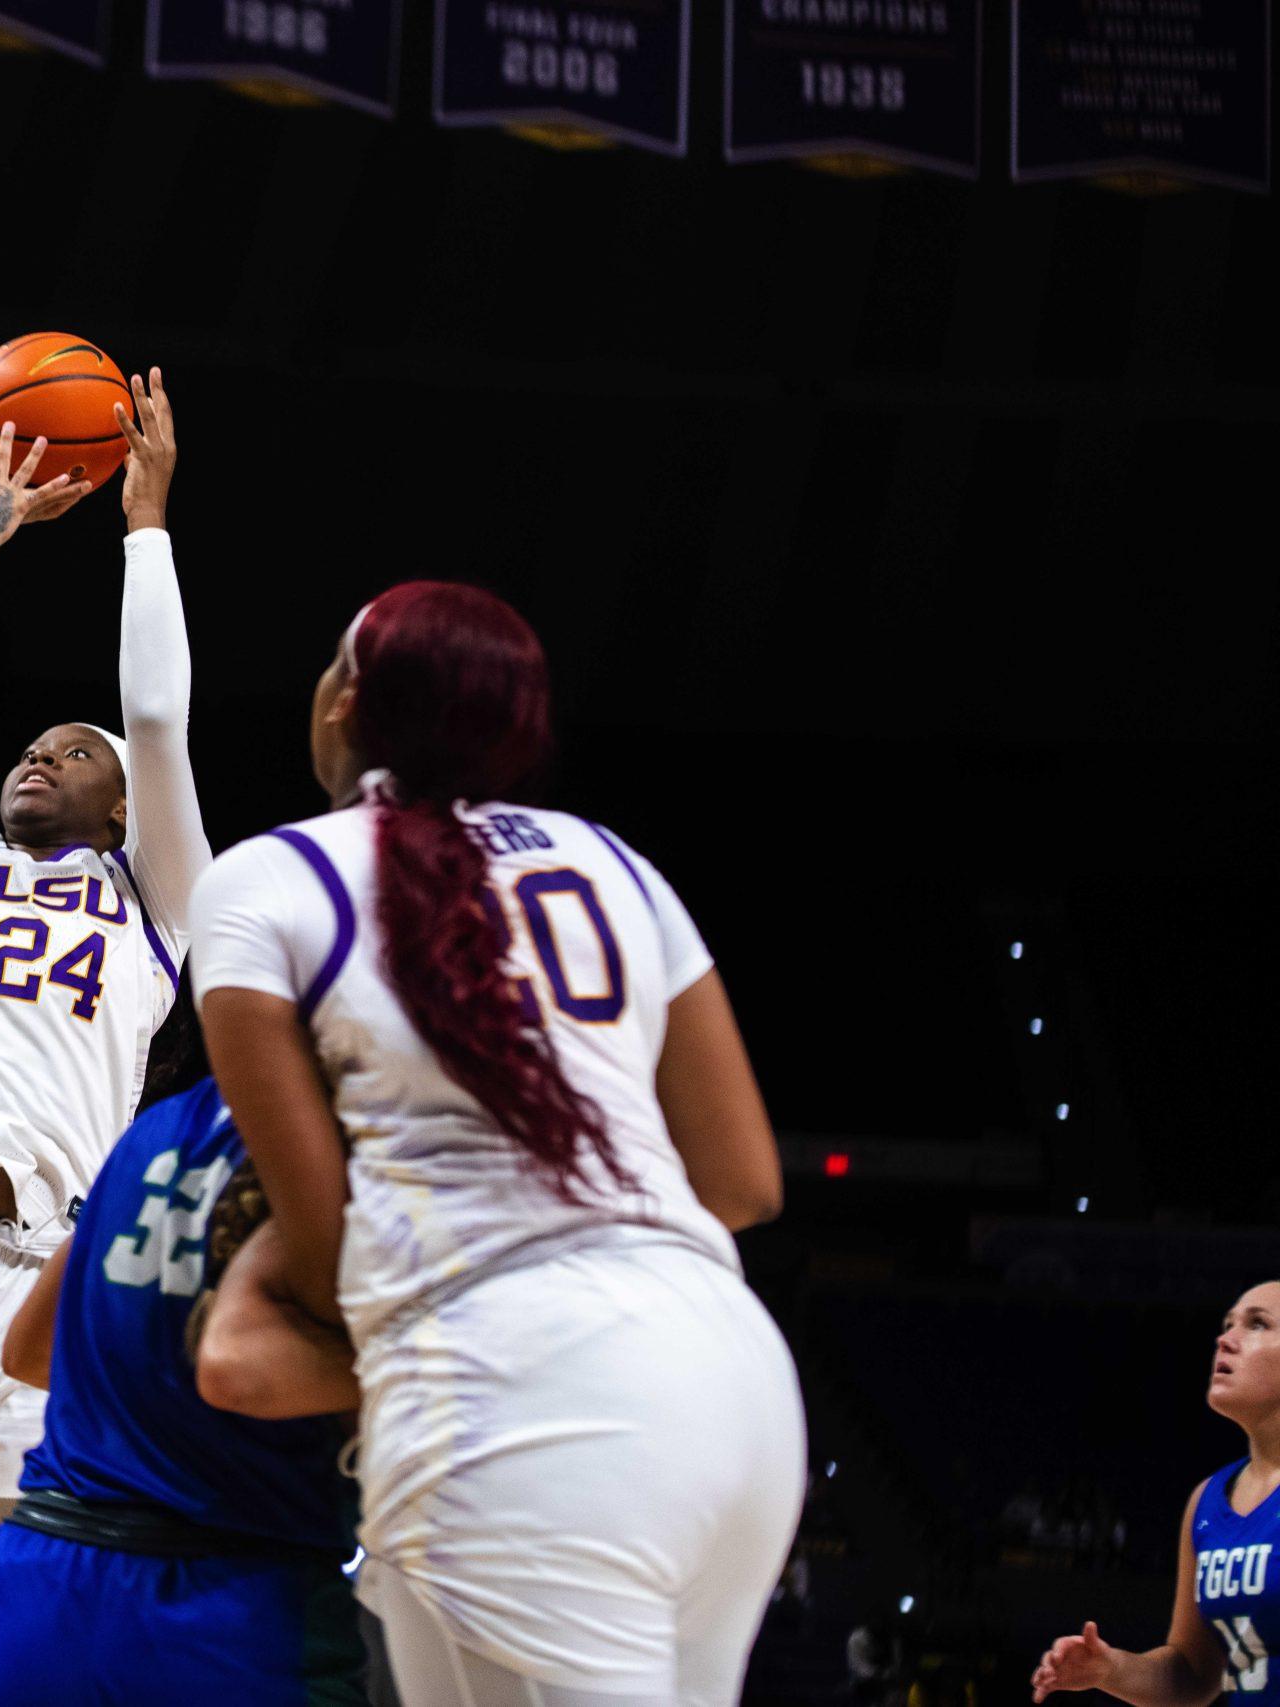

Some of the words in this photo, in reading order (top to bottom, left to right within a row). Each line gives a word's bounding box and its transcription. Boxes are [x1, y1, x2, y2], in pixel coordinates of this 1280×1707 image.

[485, 3, 559, 40] FINAL
[567, 13, 639, 50] FOUR
[502, 39, 619, 97] 2006
[102, 1147, 232, 1299] 32
[1194, 1543, 1273, 1603] FGCU
